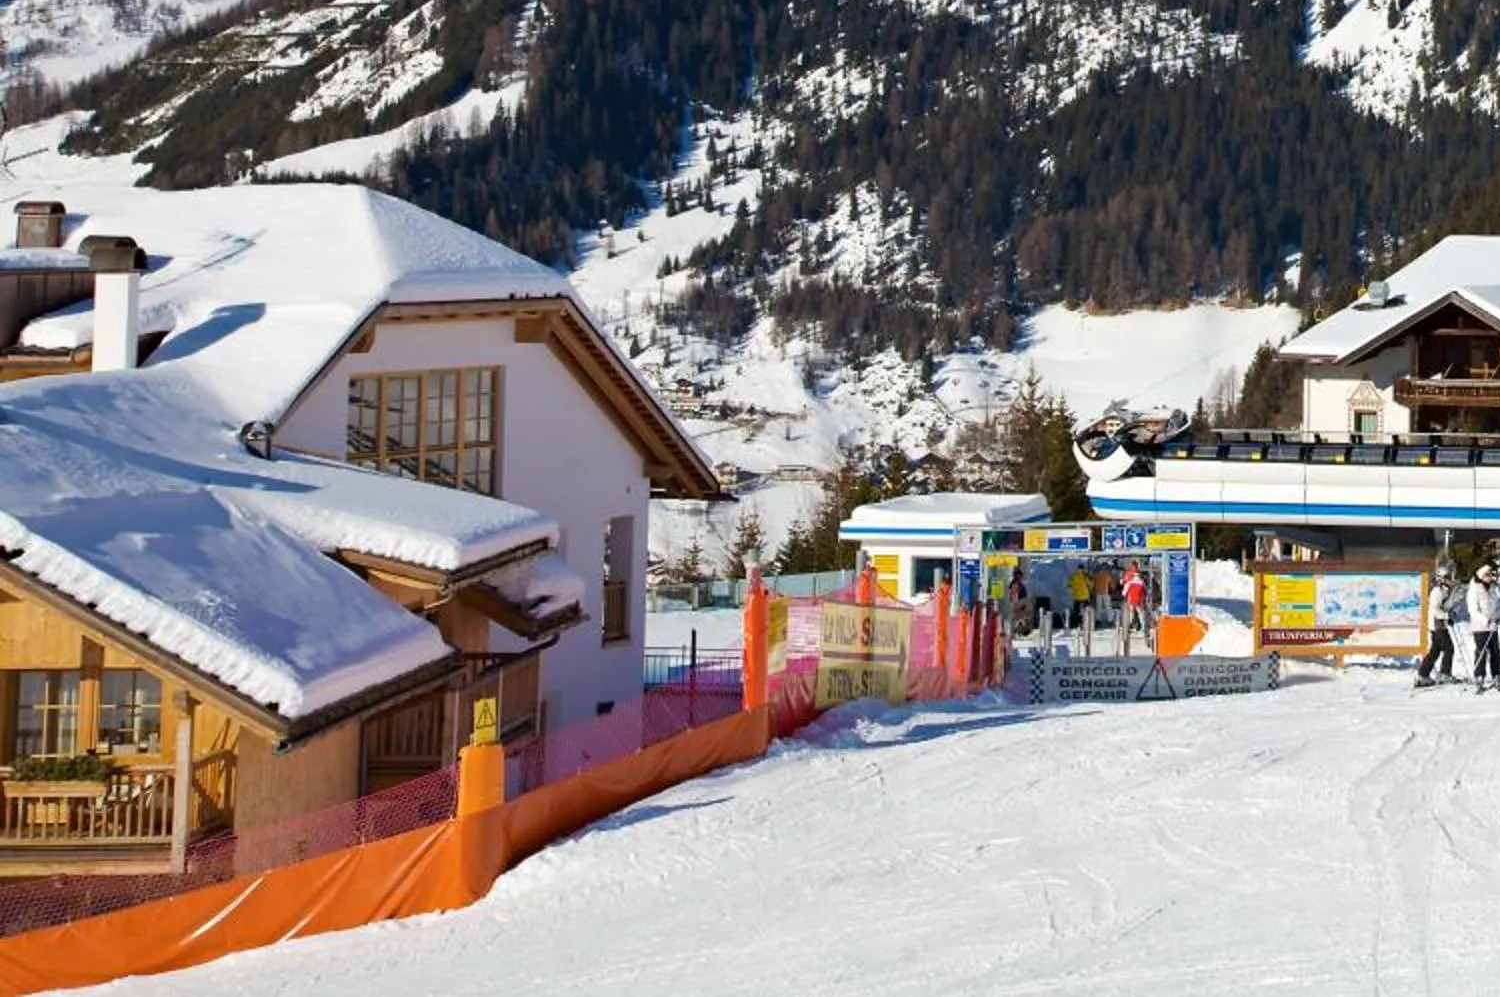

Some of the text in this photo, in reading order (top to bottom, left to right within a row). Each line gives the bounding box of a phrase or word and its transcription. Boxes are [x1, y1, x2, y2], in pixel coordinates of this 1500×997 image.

[1052, 666, 1139, 676] PERICOLO
[1177, 662, 1261, 676] PERICOLO
[1059, 678, 1129, 688] DANGER
[1183, 674, 1253, 687] DANGER
[1059, 690, 1127, 700] GEFAHR
[1185, 685, 1251, 698] GEFAHR
